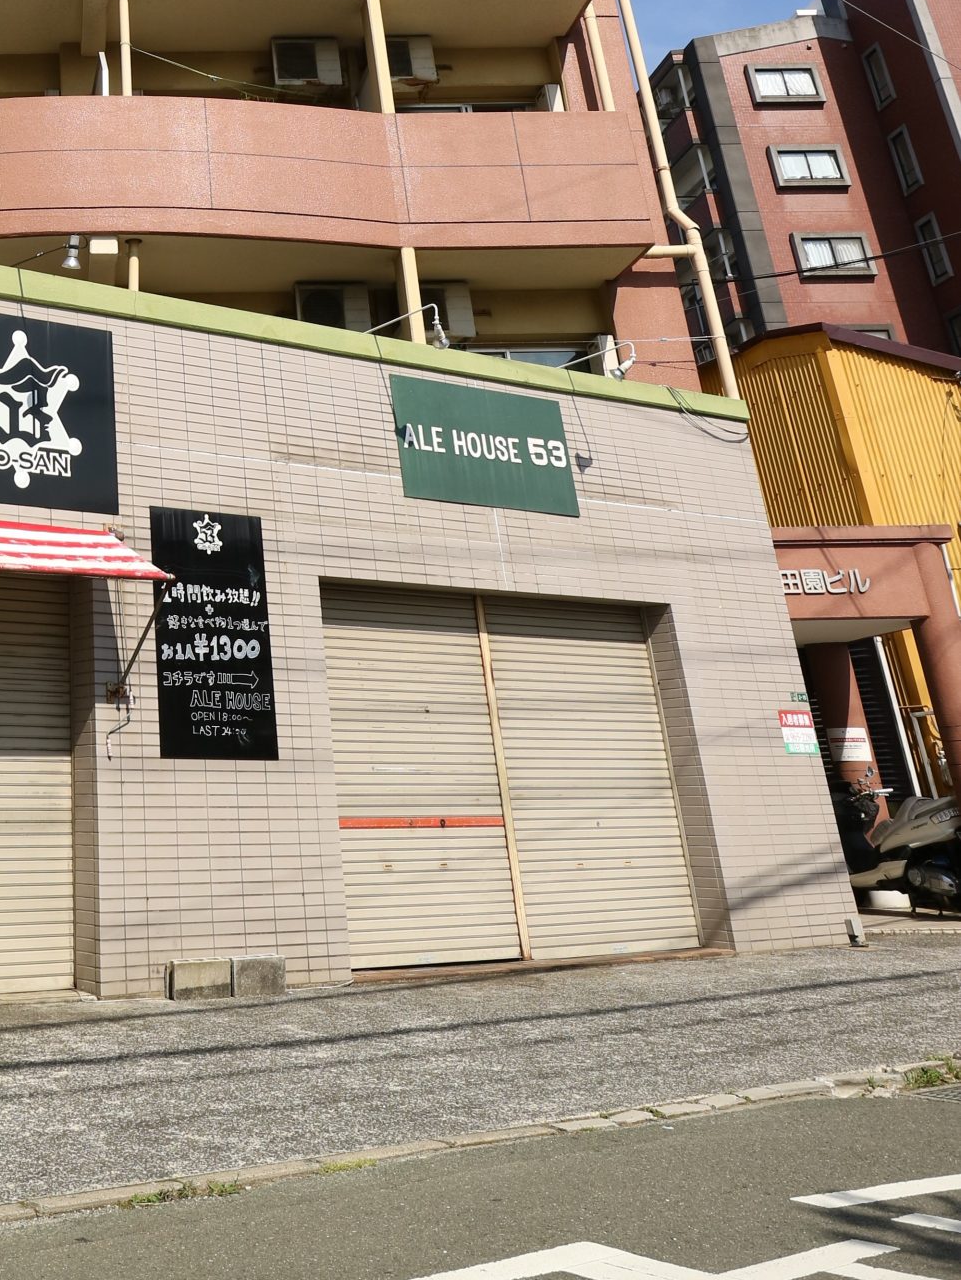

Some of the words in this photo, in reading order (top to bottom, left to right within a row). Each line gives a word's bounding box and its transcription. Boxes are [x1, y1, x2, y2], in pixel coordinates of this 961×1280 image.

[403, 423, 446, 453] ALE
[452, 429, 523, 464] HOUSE
[527, 437, 568, 468] 53
[779, 568, 871, 594] 田園ビル
[189, 689, 222, 709] ALE
[225, 691, 271, 711] HOUSE
[190, 711, 216, 721] OPEN
[192, 724, 220, 737] LAST
